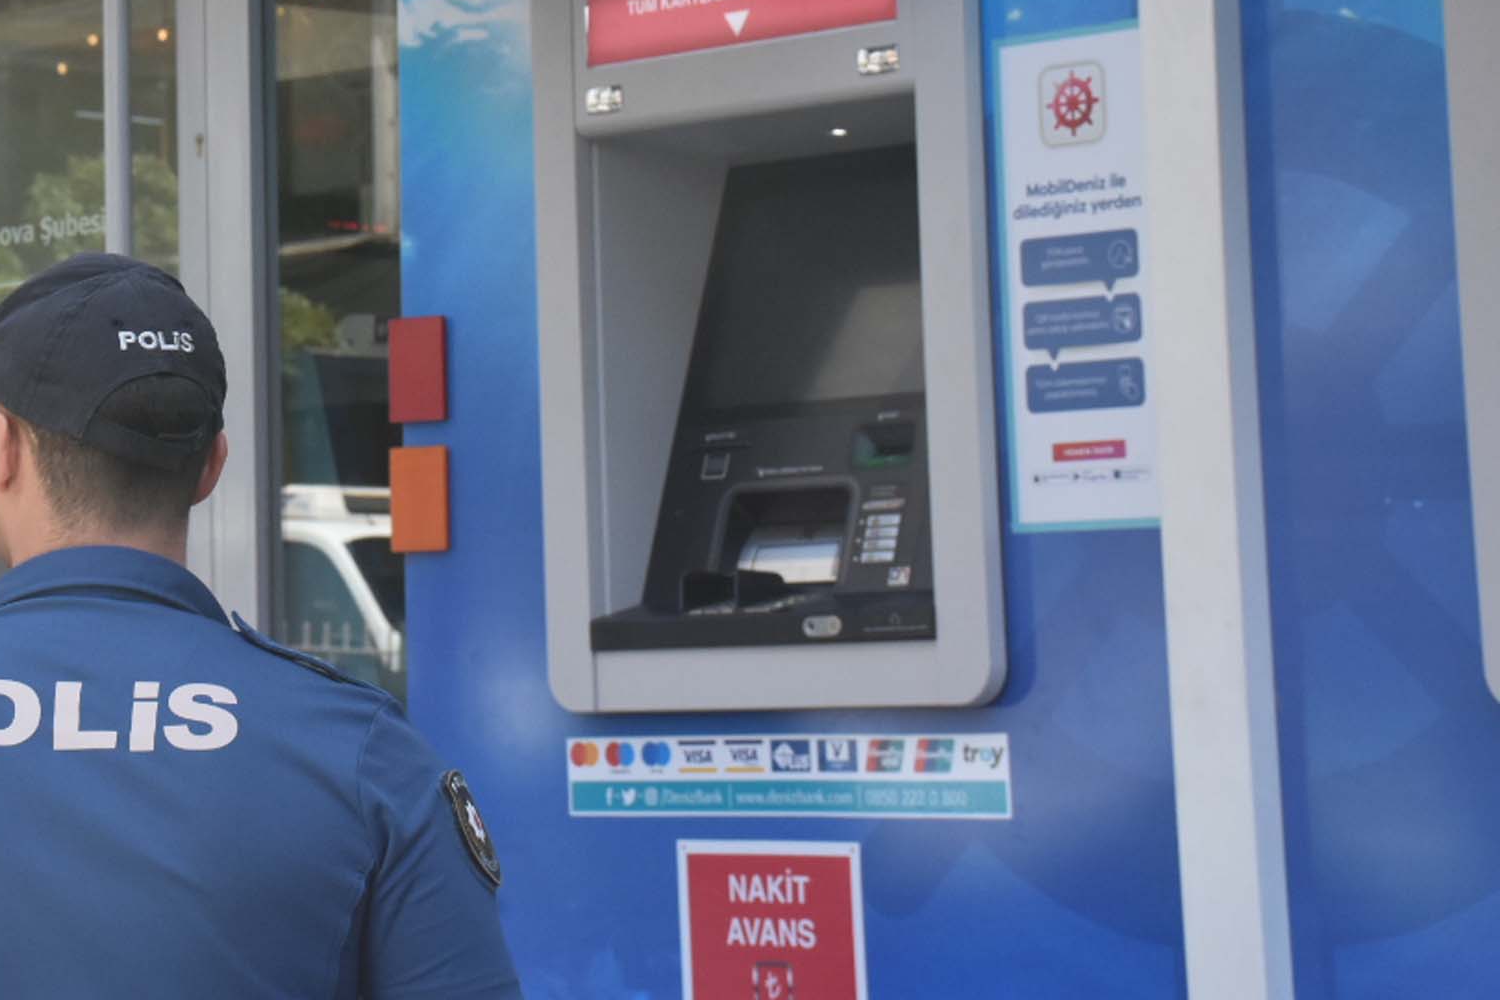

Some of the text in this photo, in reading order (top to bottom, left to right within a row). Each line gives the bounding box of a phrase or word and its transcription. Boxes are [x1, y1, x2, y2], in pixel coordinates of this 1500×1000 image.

[683, 749, 714, 764] VISA
[730, 748, 760, 762] VISA
[962, 744, 1004, 769] troy
[727, 868, 810, 905] NAKİT
[726, 916, 817, 949] AVANS
